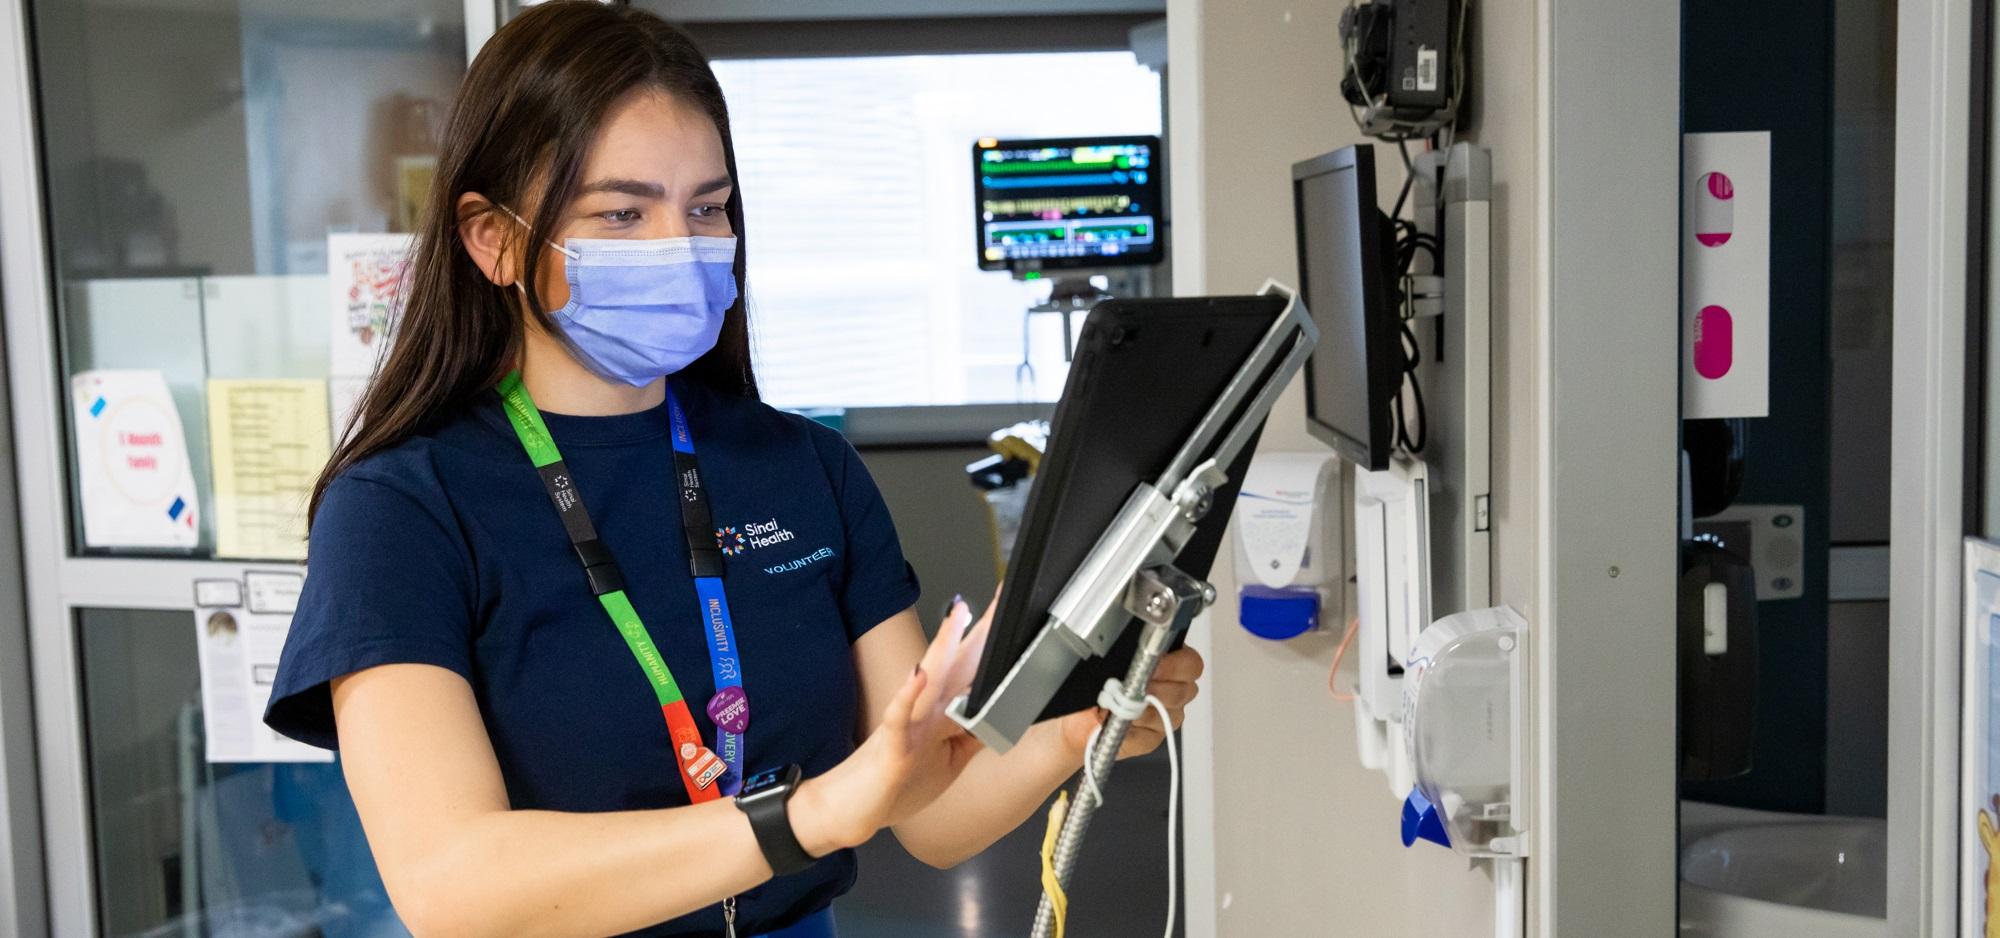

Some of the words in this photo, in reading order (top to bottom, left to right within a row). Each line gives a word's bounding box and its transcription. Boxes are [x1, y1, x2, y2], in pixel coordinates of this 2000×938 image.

[554, 491, 568, 512] System
[560, 490, 572, 509] Health
[744, 517, 779, 536] Sinai
[749, 529, 795, 550] Health
[763, 546, 836, 575] VOLUNTEER
[708, 598, 729, 652] INCLUSIVITY
[635, 641, 669, 686] HUMANITY
[715, 697, 746, 721] PREEMIE
[720, 704, 747, 726] LOVE
[724, 731, 737, 763] OVERY
